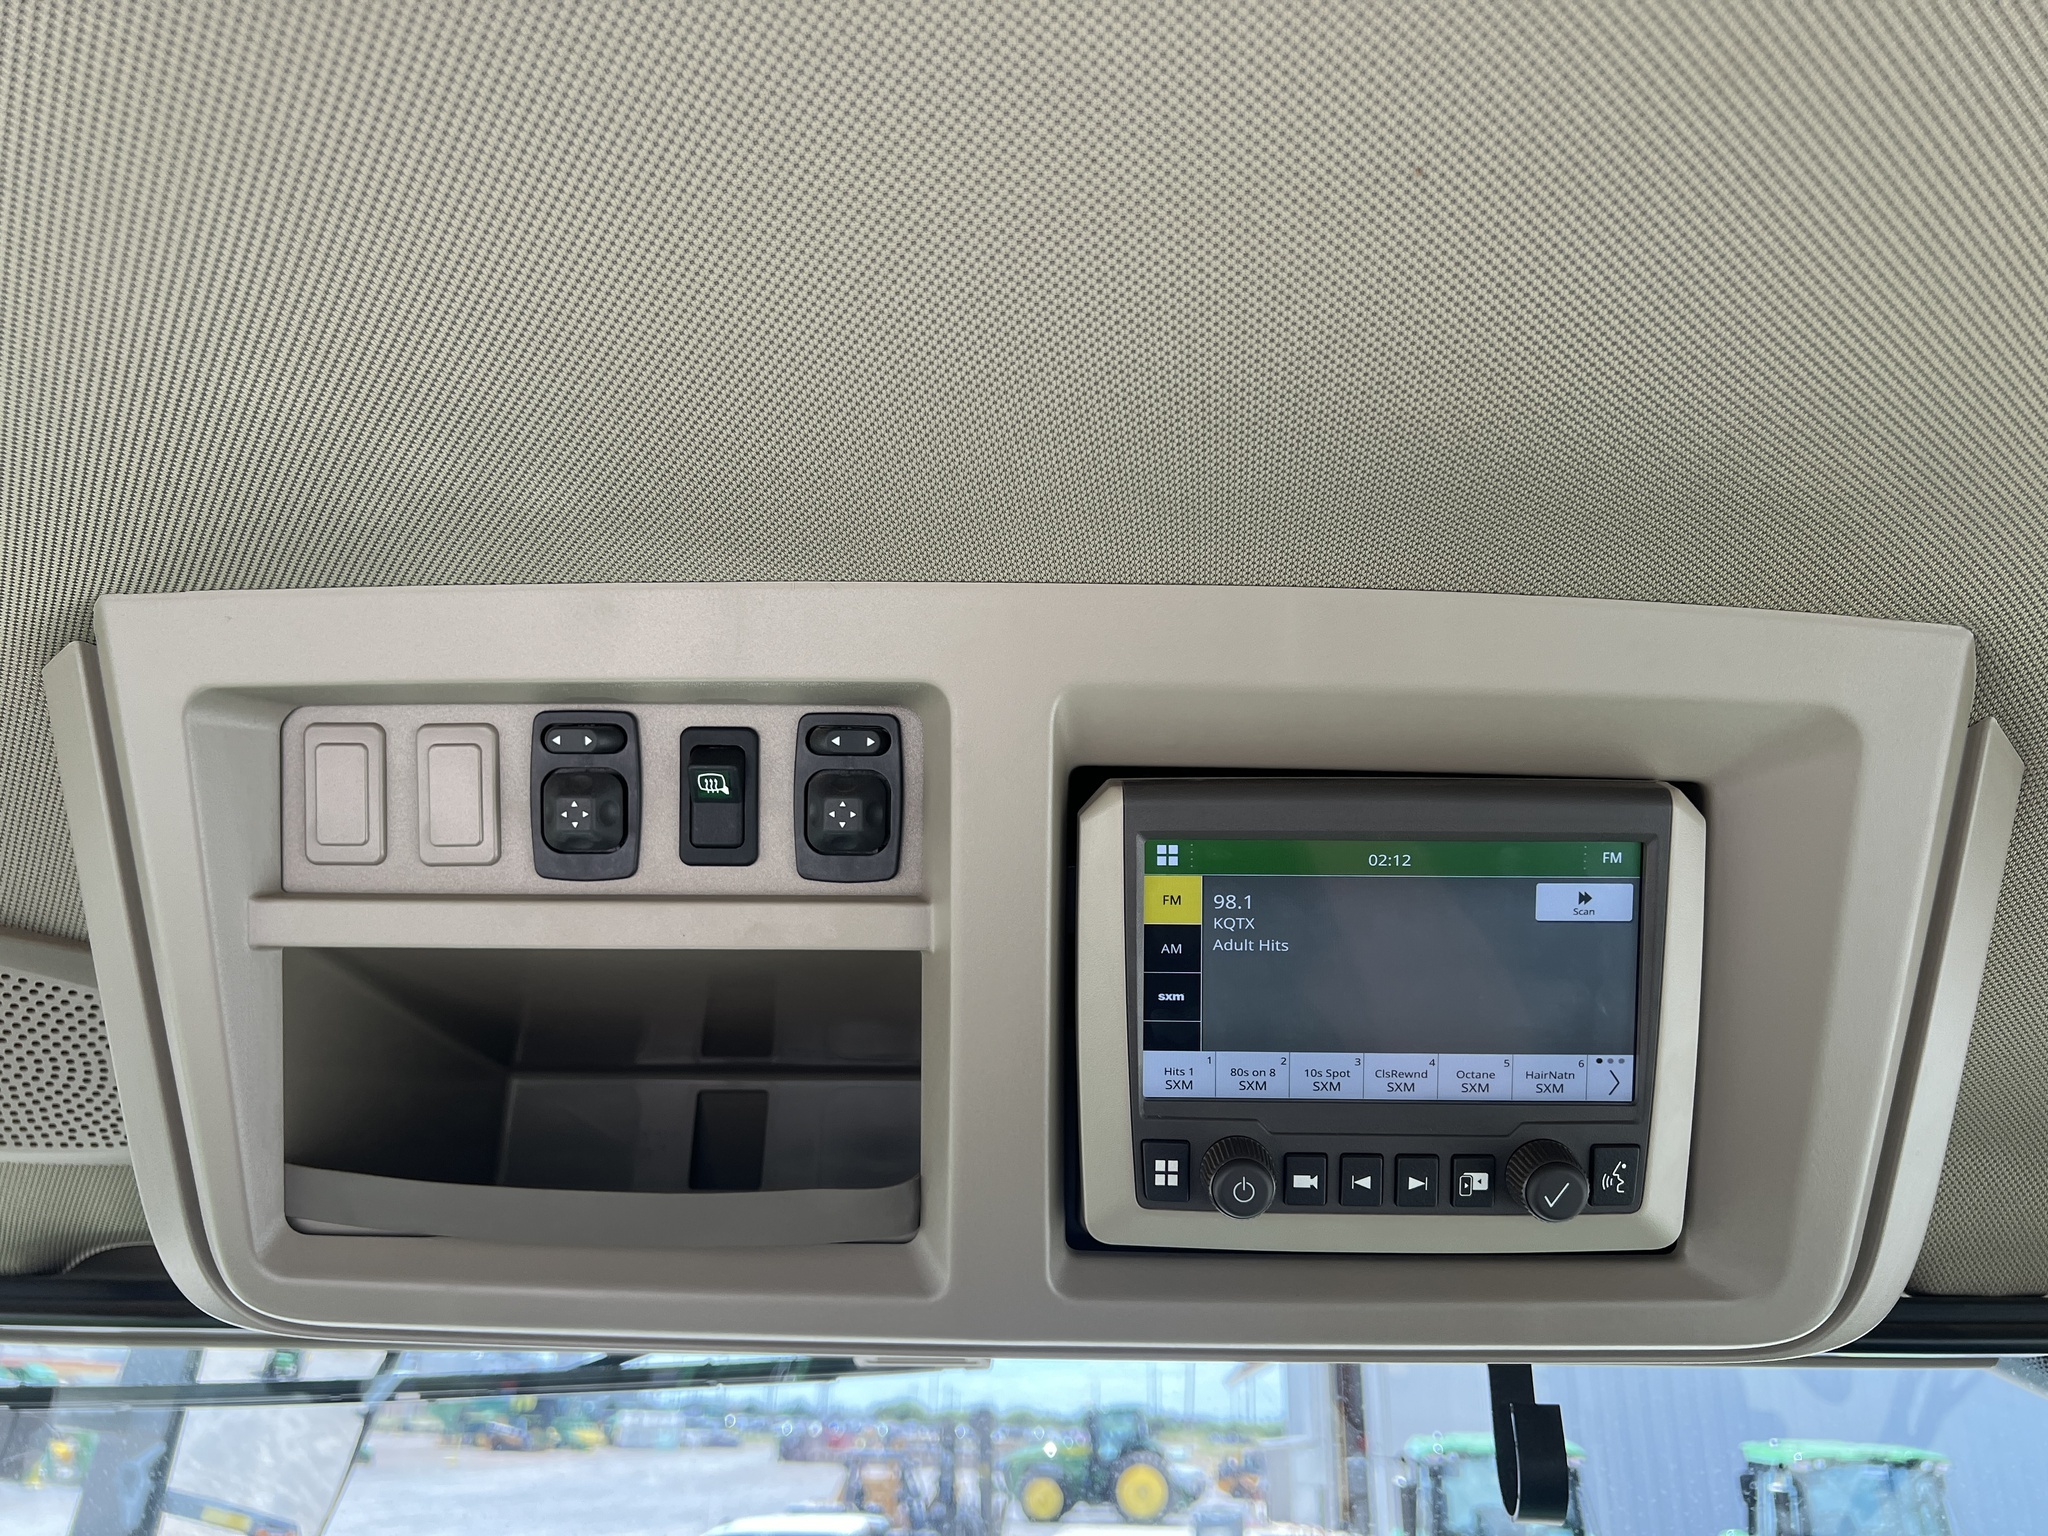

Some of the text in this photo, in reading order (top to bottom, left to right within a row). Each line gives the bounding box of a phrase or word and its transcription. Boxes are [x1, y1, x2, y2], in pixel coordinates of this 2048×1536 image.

[1368, 854, 1411, 867] 02:12
[1602, 851, 1622, 864] FM
[1162, 894, 1182, 906] FM
[1213, 894, 1251, 910] 98.1
[1572, 907, 1595, 916] Scan
[1213, 917, 1255, 932] KQTX
[1160, 943, 1182, 955] AM
[1212, 938, 1289, 952] Adult Hits
[1157, 993, 1185, 1002] sxm
[1207, 1056, 1212, 1065] 1
[1280, 1056, 1287, 1066] 2
[1354, 1057, 1362, 1067] 3
[1428, 1058, 1436, 1067] 4
[1503, 1059, 1511, 1068] 5
[1578, 1059, 1585, 1068] 6
[1164, 1067, 1194, 1077] Hits 1
[1230, 1067, 1276, 1077] 80s on 8
[1304, 1068, 1351, 1080] 10s Spot
[1374, 1069, 1428, 1079] ClsRewnd
[1456, 1070, 1496, 1080] Octane
[1525, 1070, 1575, 1080] HairNatn
[1165, 1079, 1193, 1091] SXM
[1238, 1080, 1267, 1091] SXM
[1312, 1080, 1341, 1092] SXM
[1386, 1081, 1415, 1093] SXM
[1461, 1082, 1490, 1093] SXM
[1535, 1083, 1564, 1094] SXM
